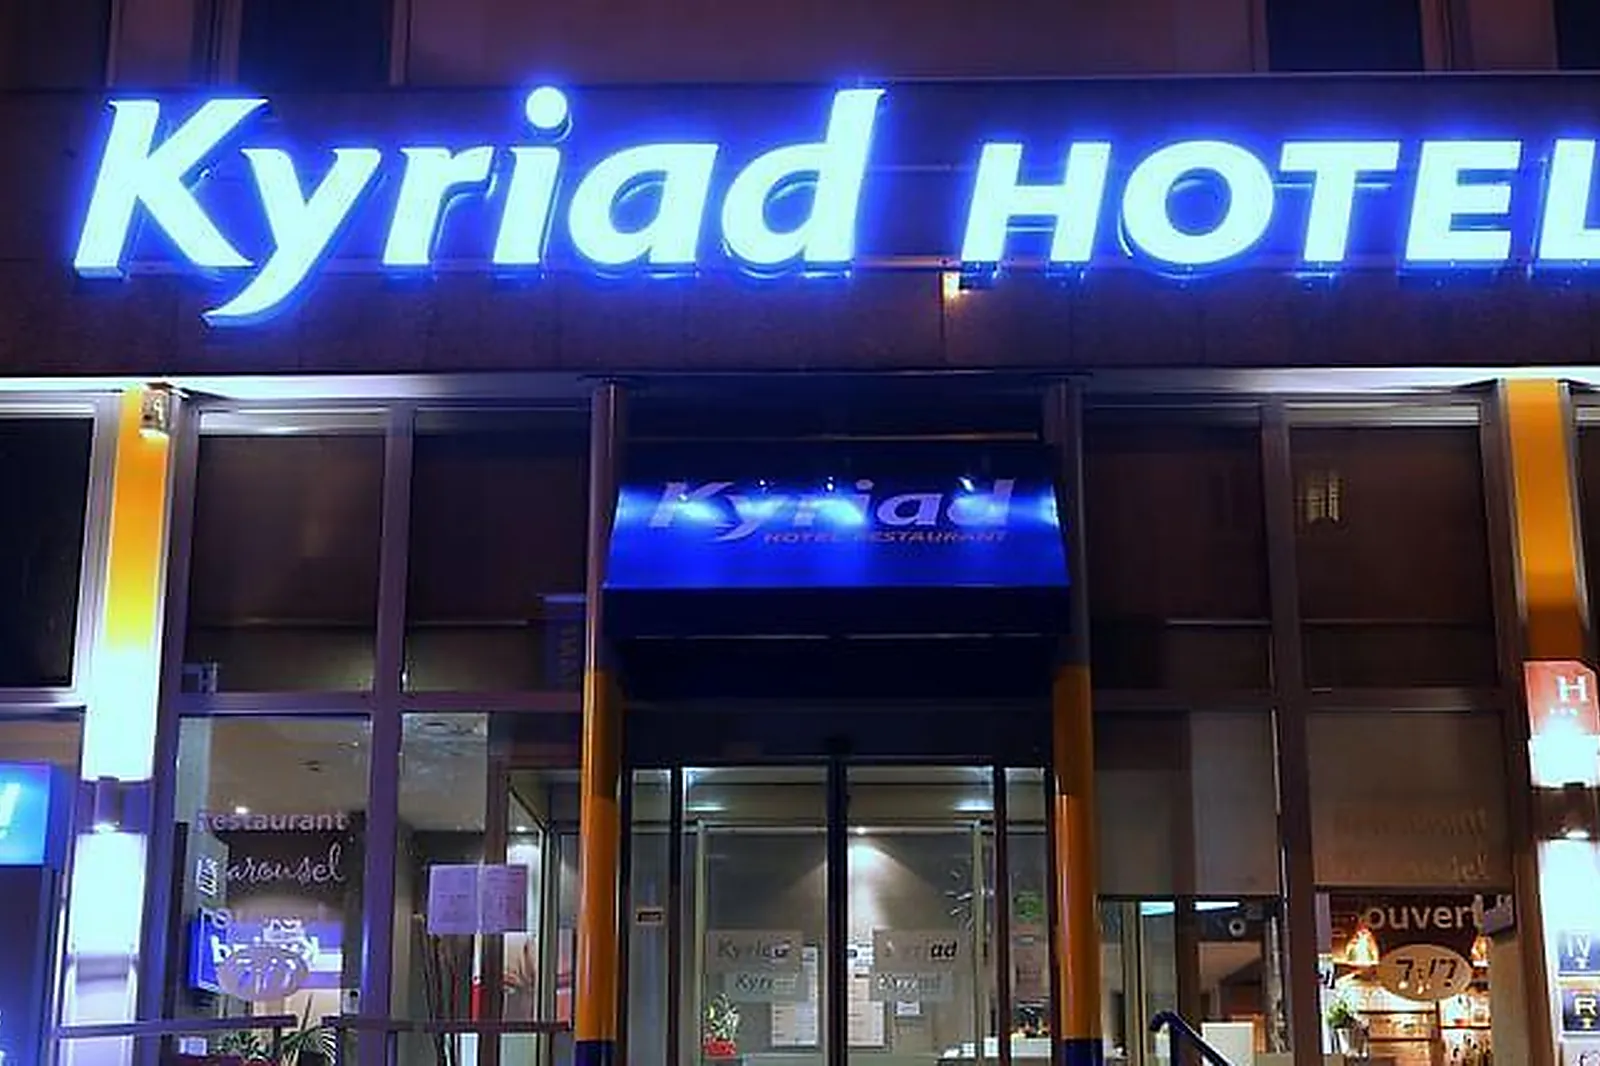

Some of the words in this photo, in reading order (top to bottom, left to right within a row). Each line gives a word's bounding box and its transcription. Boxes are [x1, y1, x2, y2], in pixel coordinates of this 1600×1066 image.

[74, 86, 887, 328] Kyriad
[961, 139, 1600, 264] HOTEL
[649, 479, 1015, 541] Kyriad
[763, 531, 842, 544] HOTEL
[853, 530, 1007, 544] ESTAURANT
[1556, 675, 1589, 704] H
[200, 842, 346, 887] arousel
[717, 938, 793, 961] Kyiad
[884, 940, 958, 960] iad
